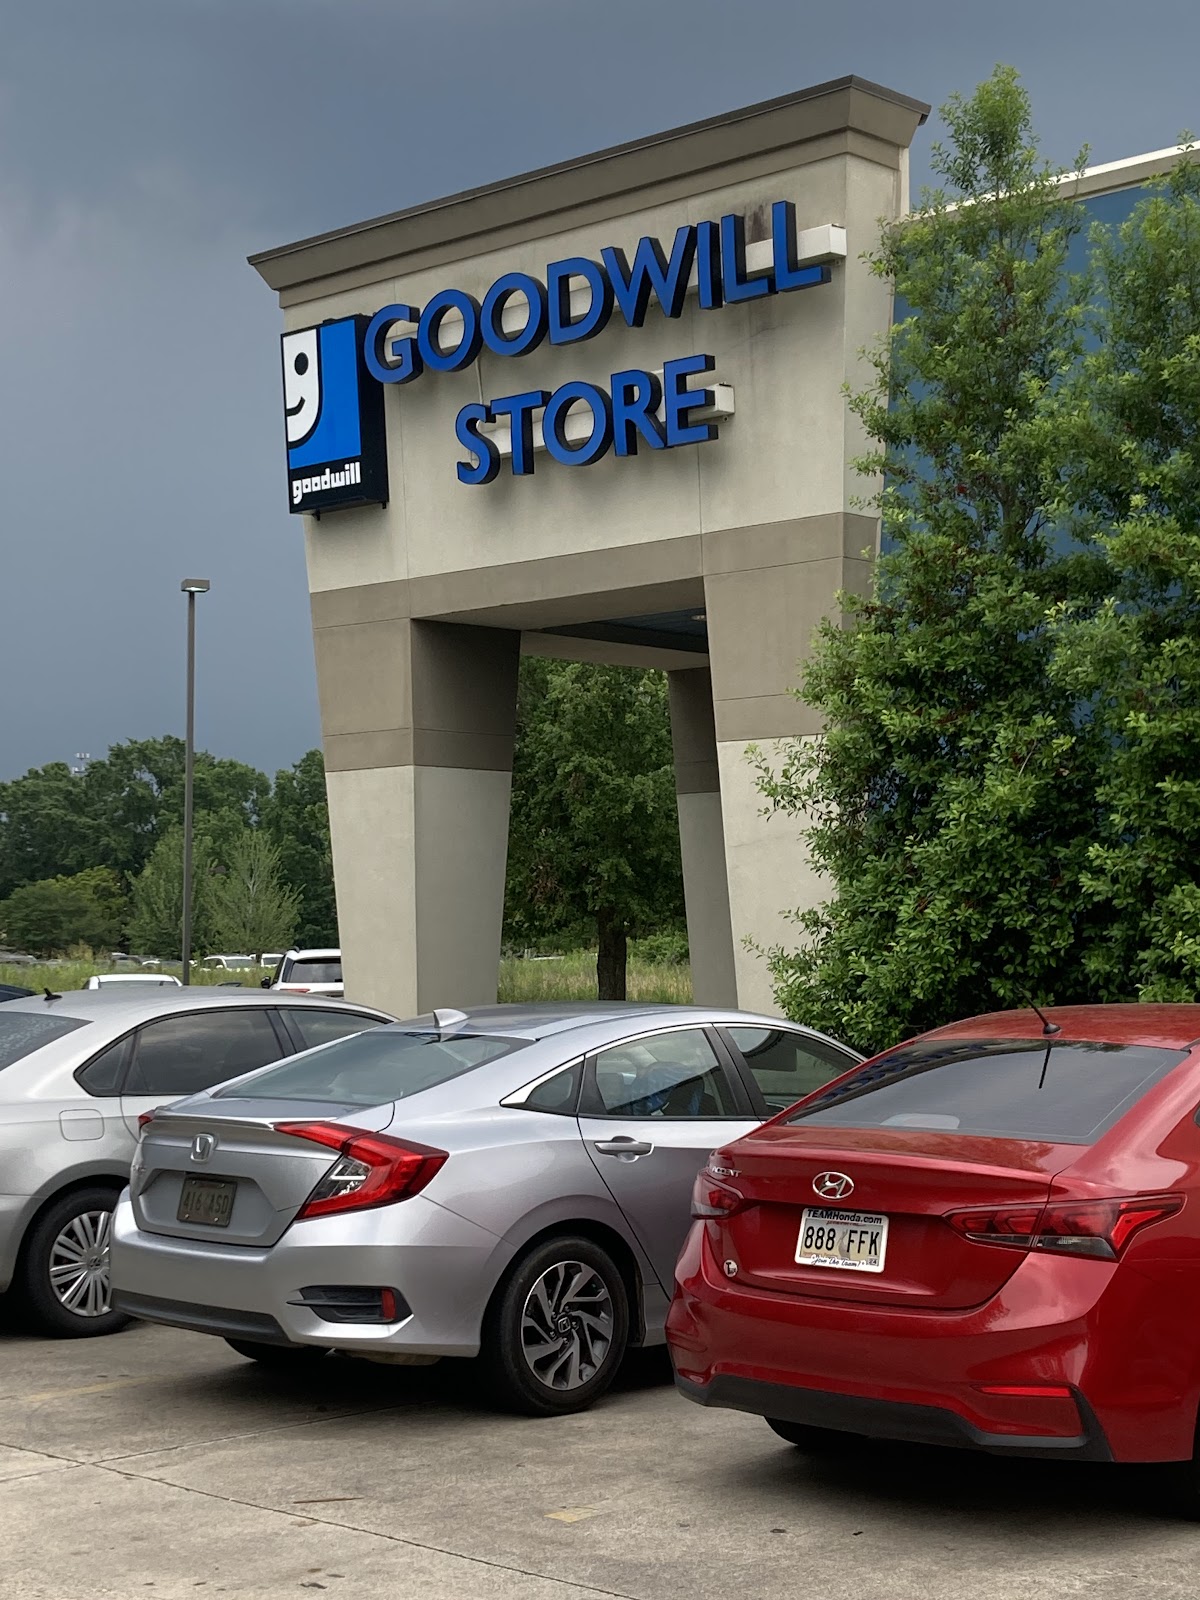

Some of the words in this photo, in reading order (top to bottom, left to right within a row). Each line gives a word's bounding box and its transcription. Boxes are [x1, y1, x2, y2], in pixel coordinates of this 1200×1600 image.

[364, 200, 832, 385] GOODWILL
[455, 354, 718, 485] STORE
[292, 461, 361, 505] goodwill
[807, 1209, 882, 1224] TEAMHonda.com
[804, 1226, 836, 1251] 888
[847, 1229, 880, 1256] FFK
